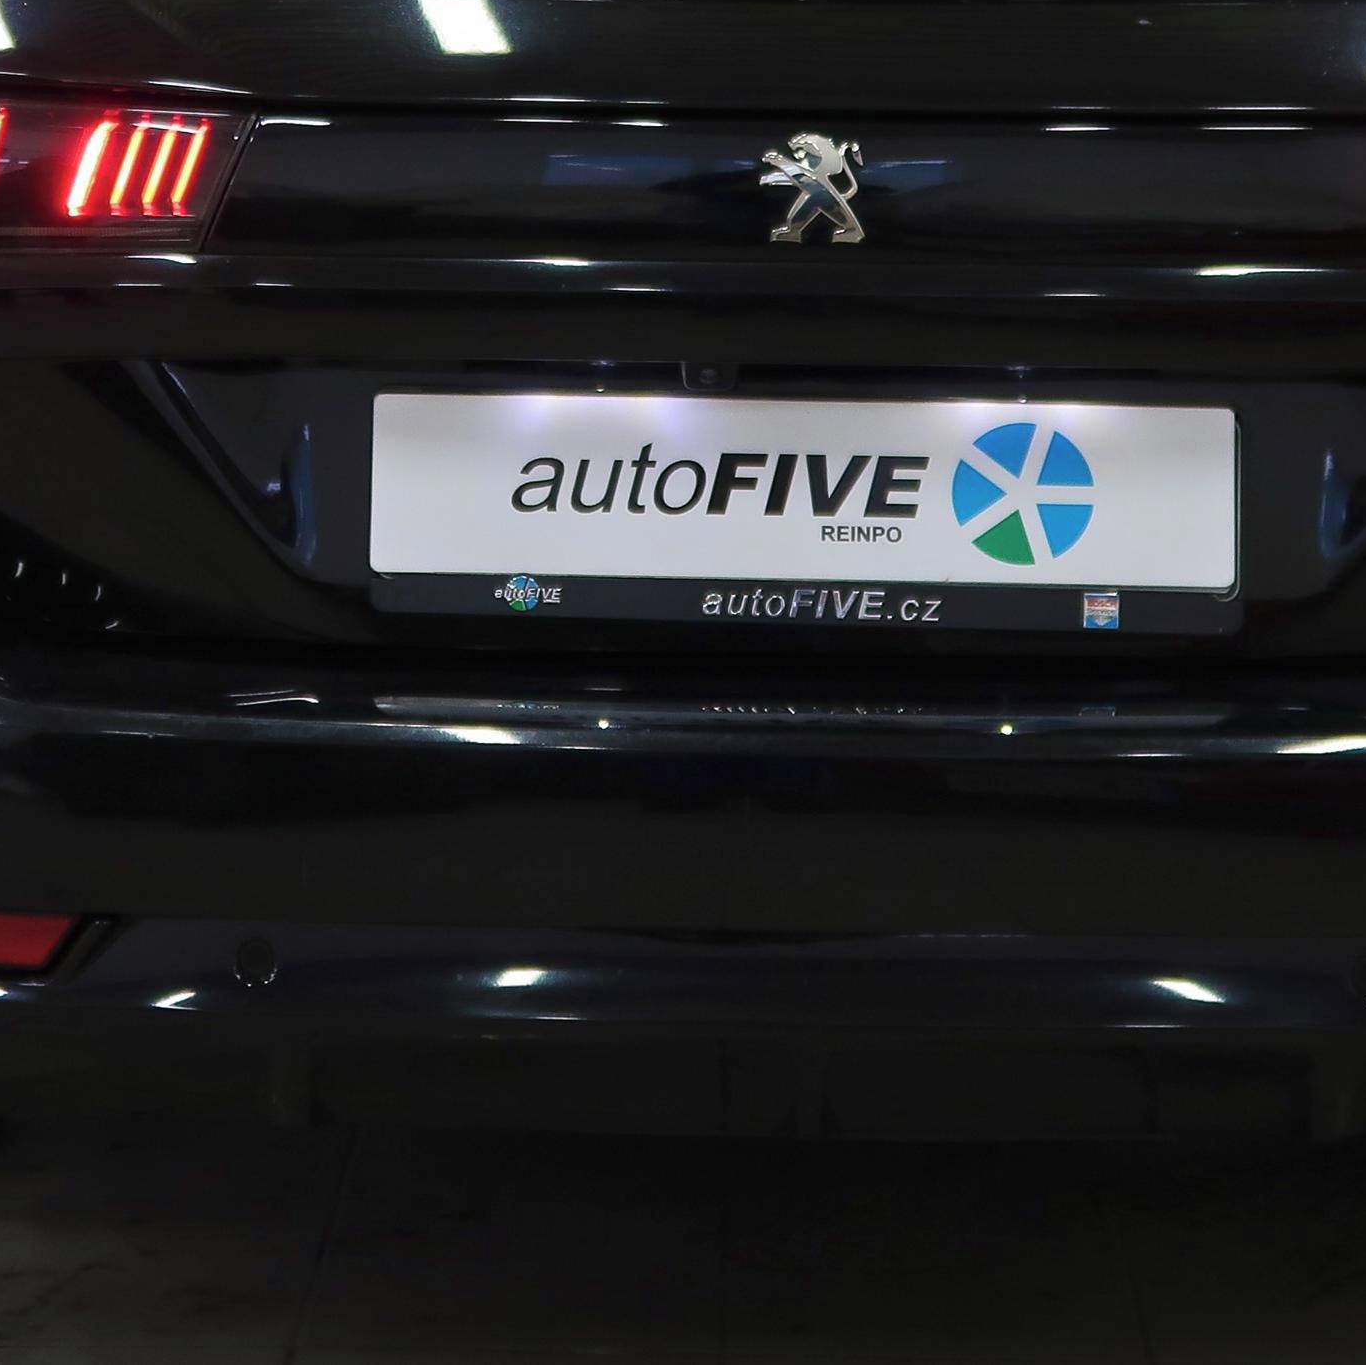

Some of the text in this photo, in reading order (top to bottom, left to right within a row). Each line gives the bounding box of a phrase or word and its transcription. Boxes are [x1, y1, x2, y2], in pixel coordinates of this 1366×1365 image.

[509, 441, 931, 520] autoFIVE
[821, 525, 903, 543] REINPO
[494, 586, 563, 603] autoFIVE
[701, 588, 943, 622] autoFIVE.cz
